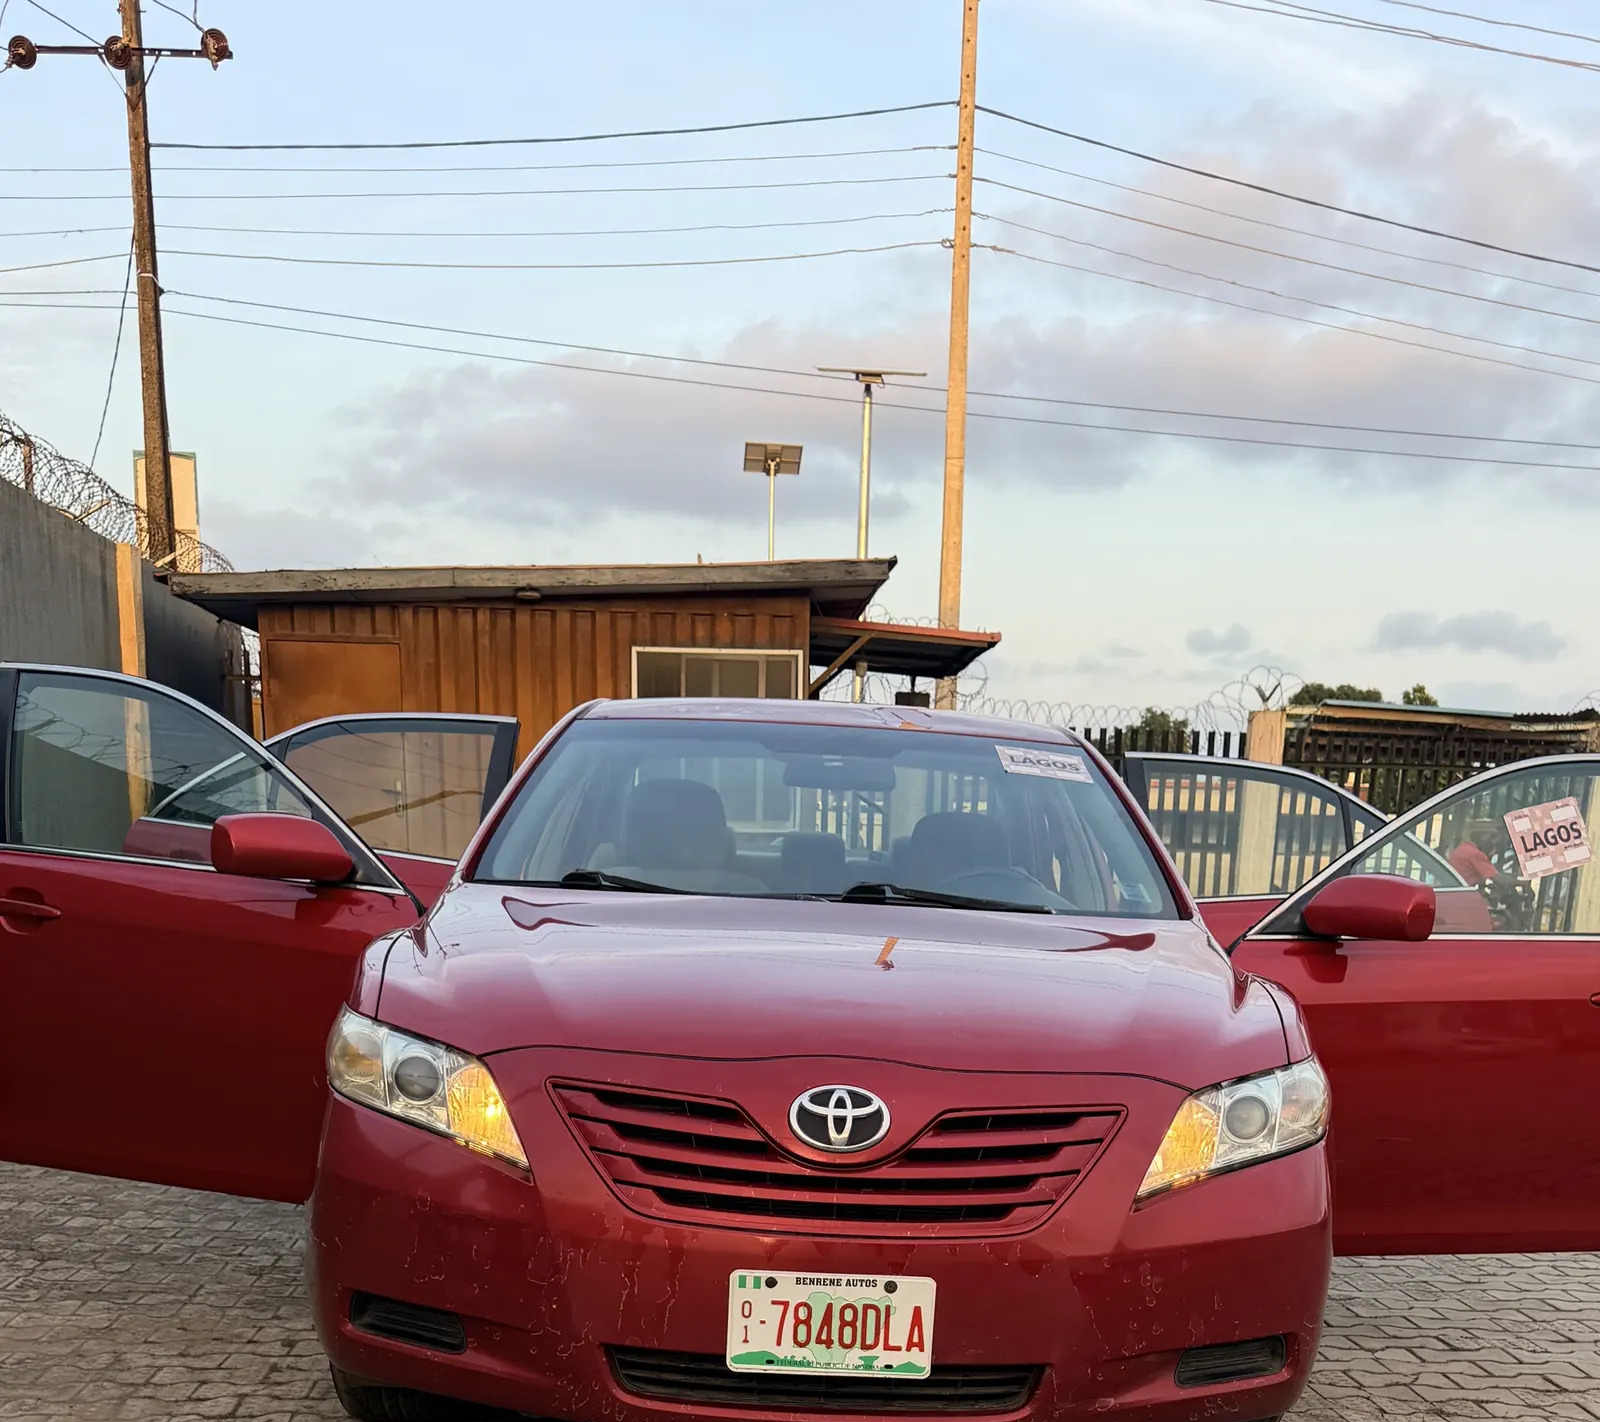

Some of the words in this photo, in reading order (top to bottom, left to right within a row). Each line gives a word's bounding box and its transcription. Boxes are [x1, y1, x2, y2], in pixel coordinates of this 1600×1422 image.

[1009, 755, 1080, 772] LAGOS
[1520, 821, 1582, 853] LAGOS
[795, 1277, 842, 1287] BENRENE
[845, 1279, 877, 1288] AUTOS
